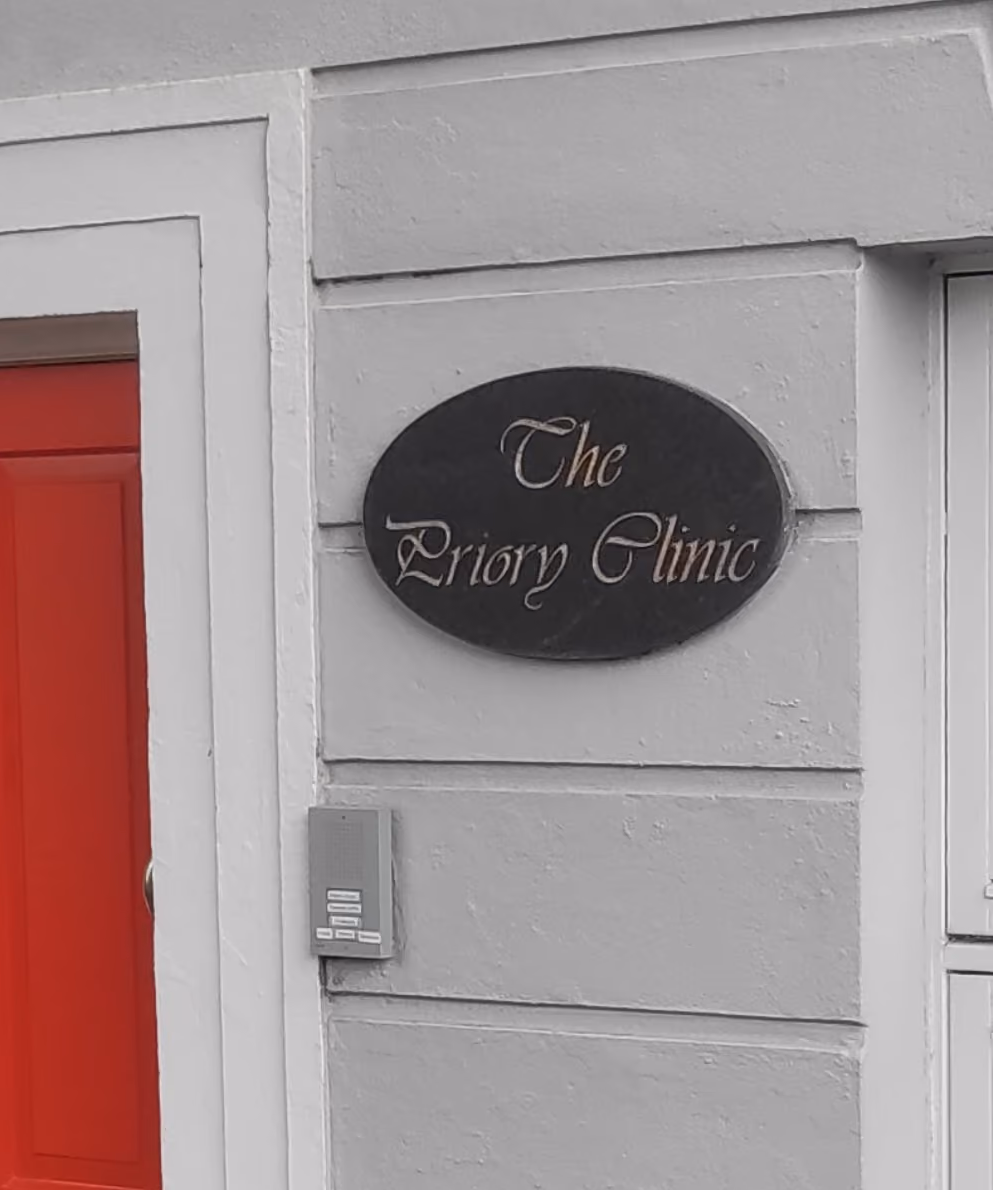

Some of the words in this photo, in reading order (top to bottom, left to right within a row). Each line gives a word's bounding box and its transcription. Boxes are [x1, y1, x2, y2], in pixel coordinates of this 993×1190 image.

[500, 416, 628, 489] The
[385, 513, 568, 610] Priory
[592, 511, 762, 585] Clinic
